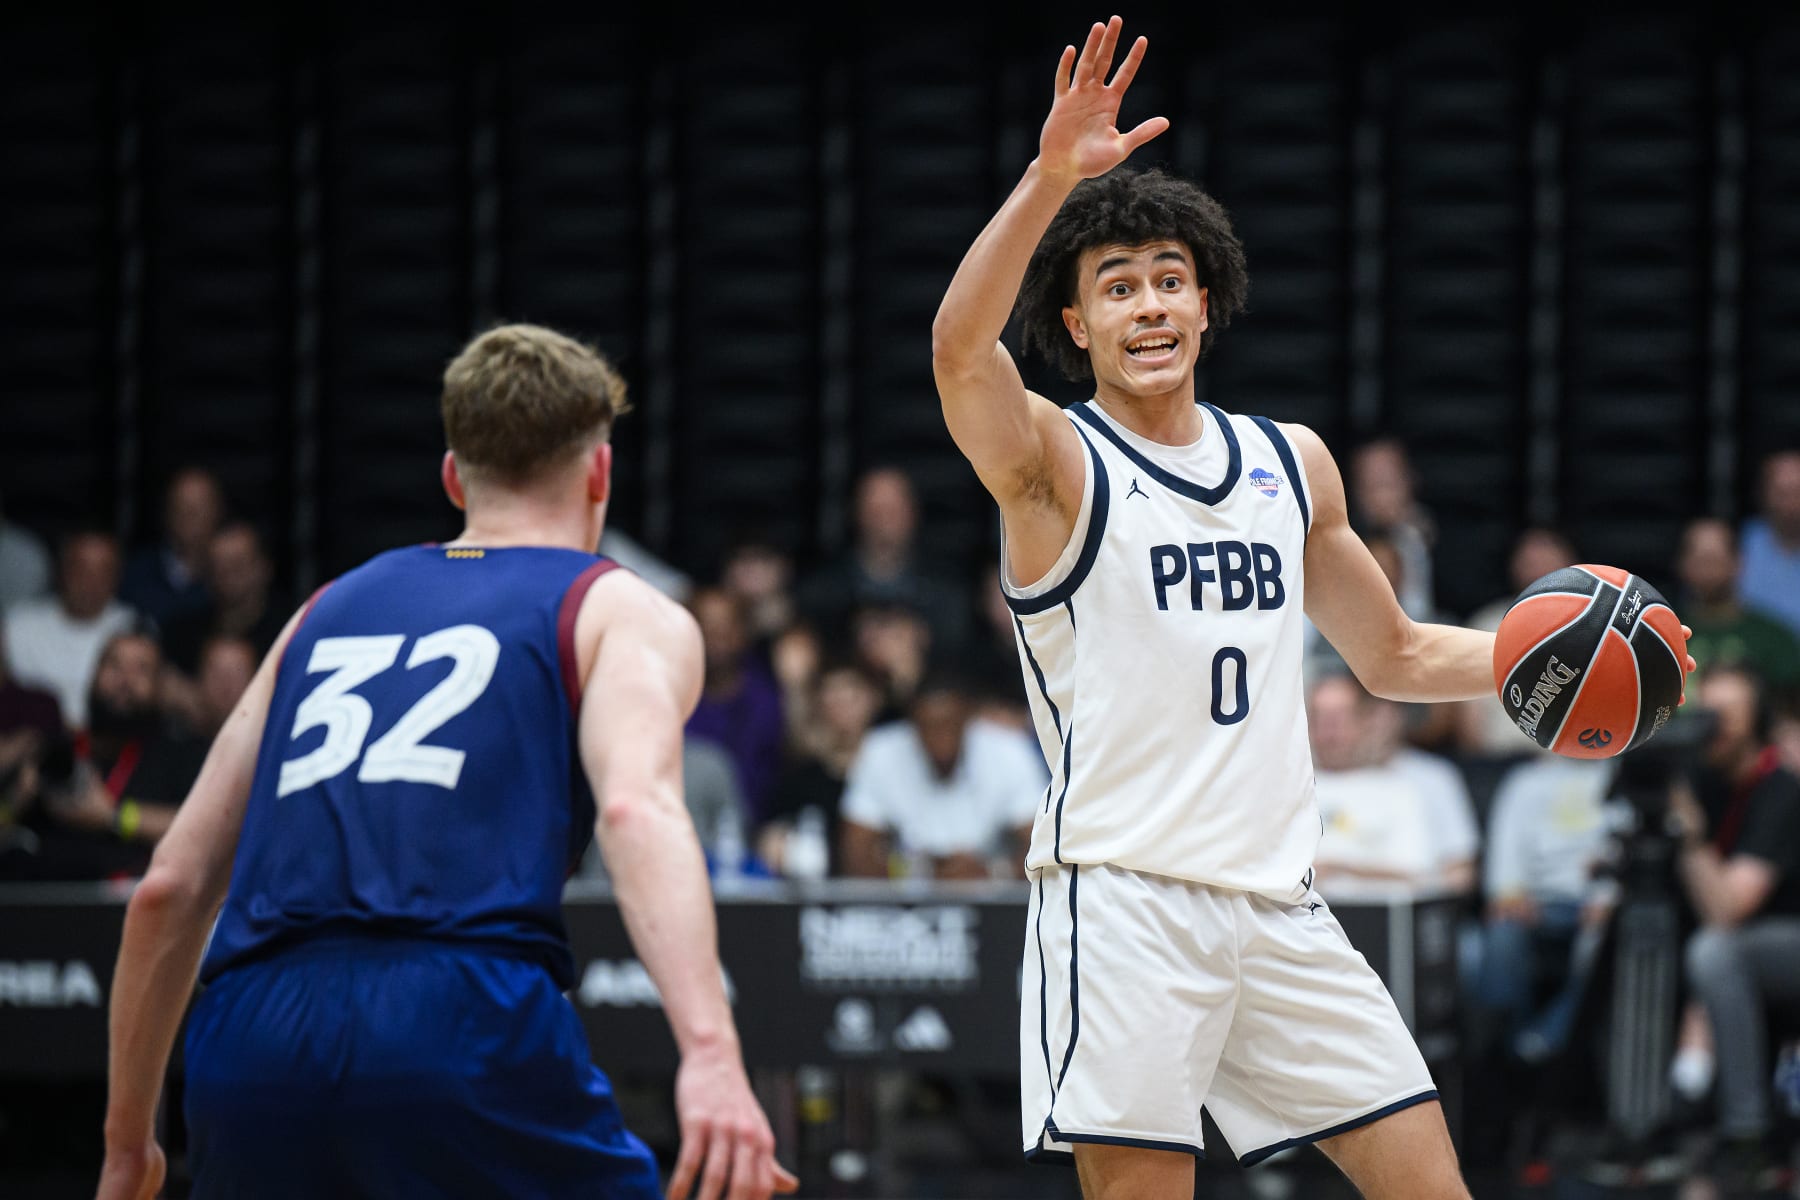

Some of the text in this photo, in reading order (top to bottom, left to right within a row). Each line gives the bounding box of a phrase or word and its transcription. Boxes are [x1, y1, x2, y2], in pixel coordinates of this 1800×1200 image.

[1150, 540, 1285, 611] PFBB
[276, 623, 501, 799] 32
[1211, 646, 1249, 726] 0
[1517, 655, 1577, 741] PALDING
